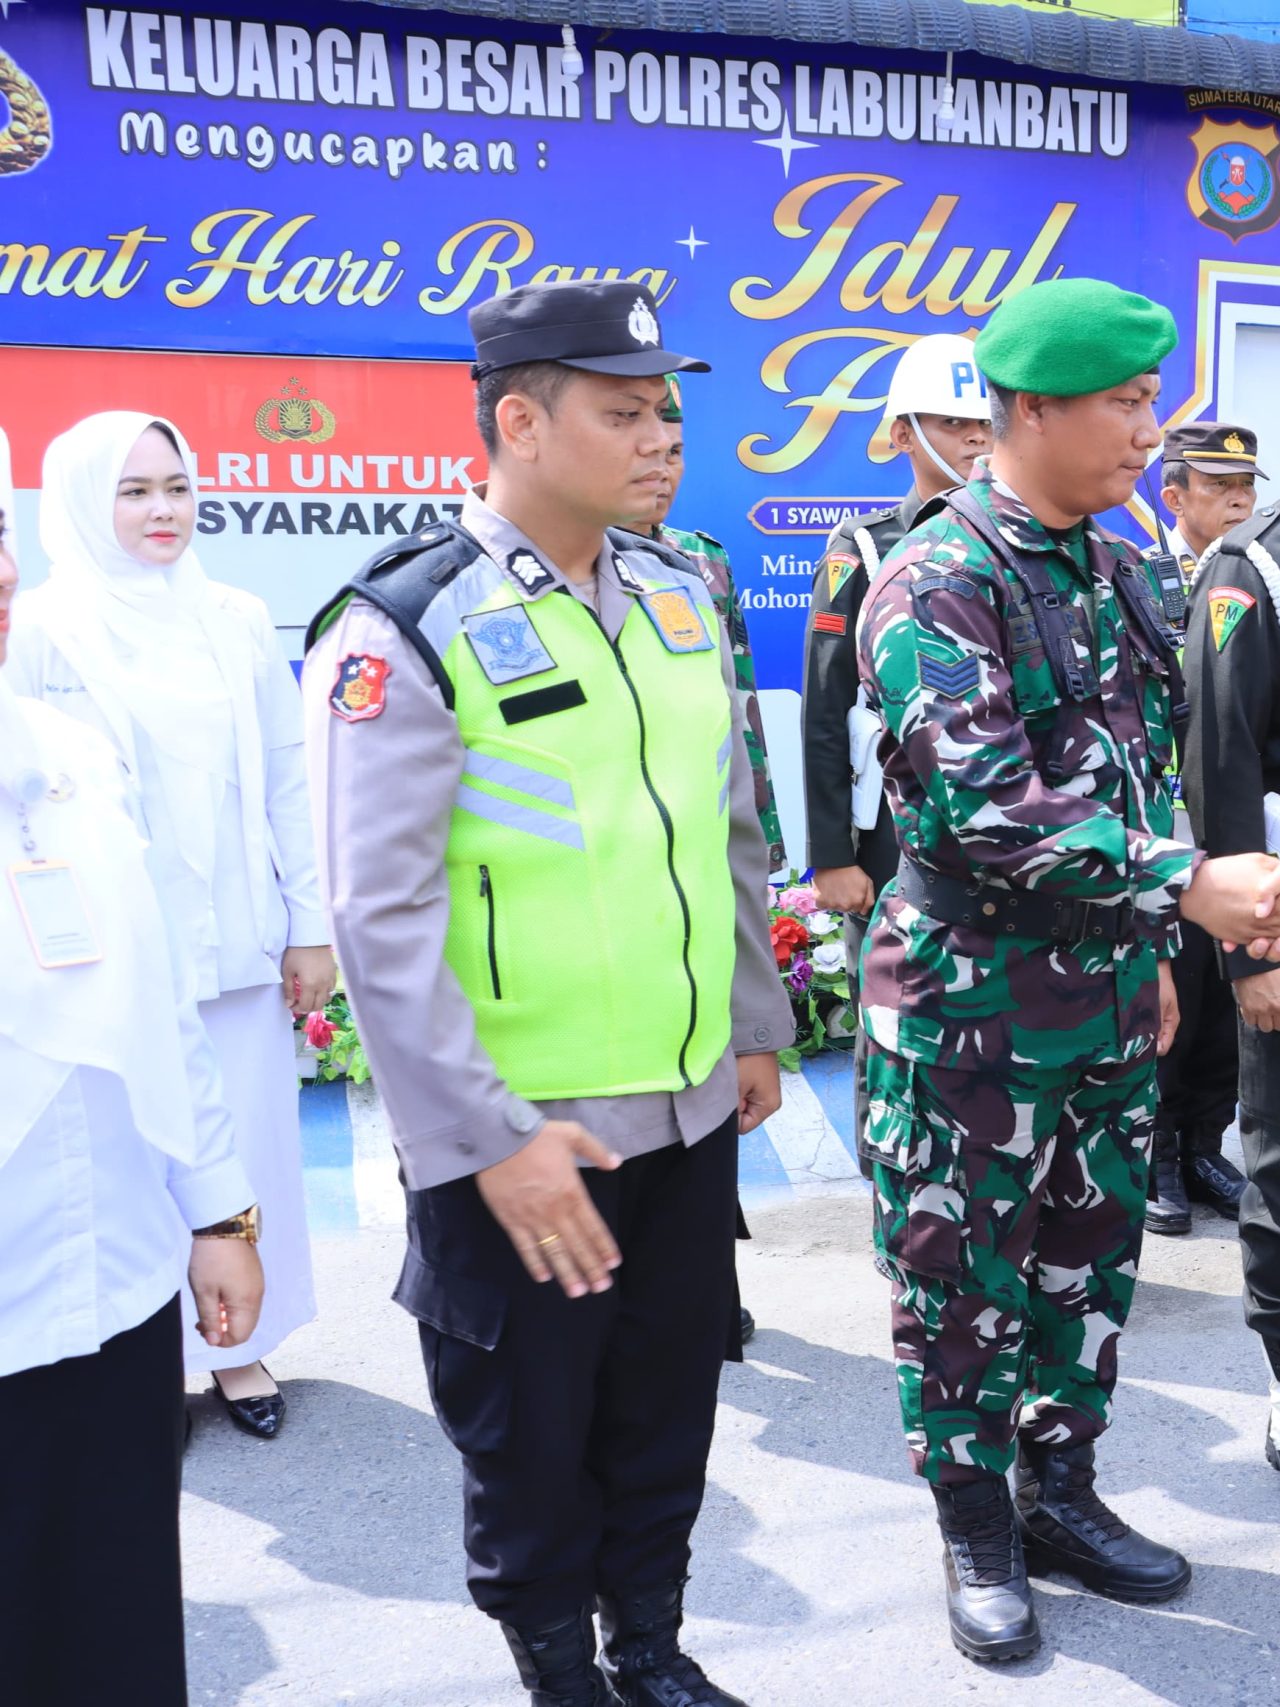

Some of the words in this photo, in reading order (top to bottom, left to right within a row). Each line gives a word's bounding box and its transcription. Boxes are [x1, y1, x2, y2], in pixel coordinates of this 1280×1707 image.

[86, 7, 394, 108] KELUARGA
[405, 35, 581, 119] BESAR
[594, 50, 782, 132] POLRES
[795, 64, 1128, 157] LABUHANBATU
[1188, 89, 1250, 107] SUMATERA
[119, 111, 517, 177] Mengucapkan
[0, 225, 167, 299] mat
[164, 208, 405, 308] Hari
[729, 172, 1078, 320] Idul
[197, 452, 270, 488] LRI
[290, 454, 474, 490] UNTUK
[196, 500, 464, 536] SYARAKA
[771, 508, 779, 524] 1
[1215, 603, 1239, 621] PM
